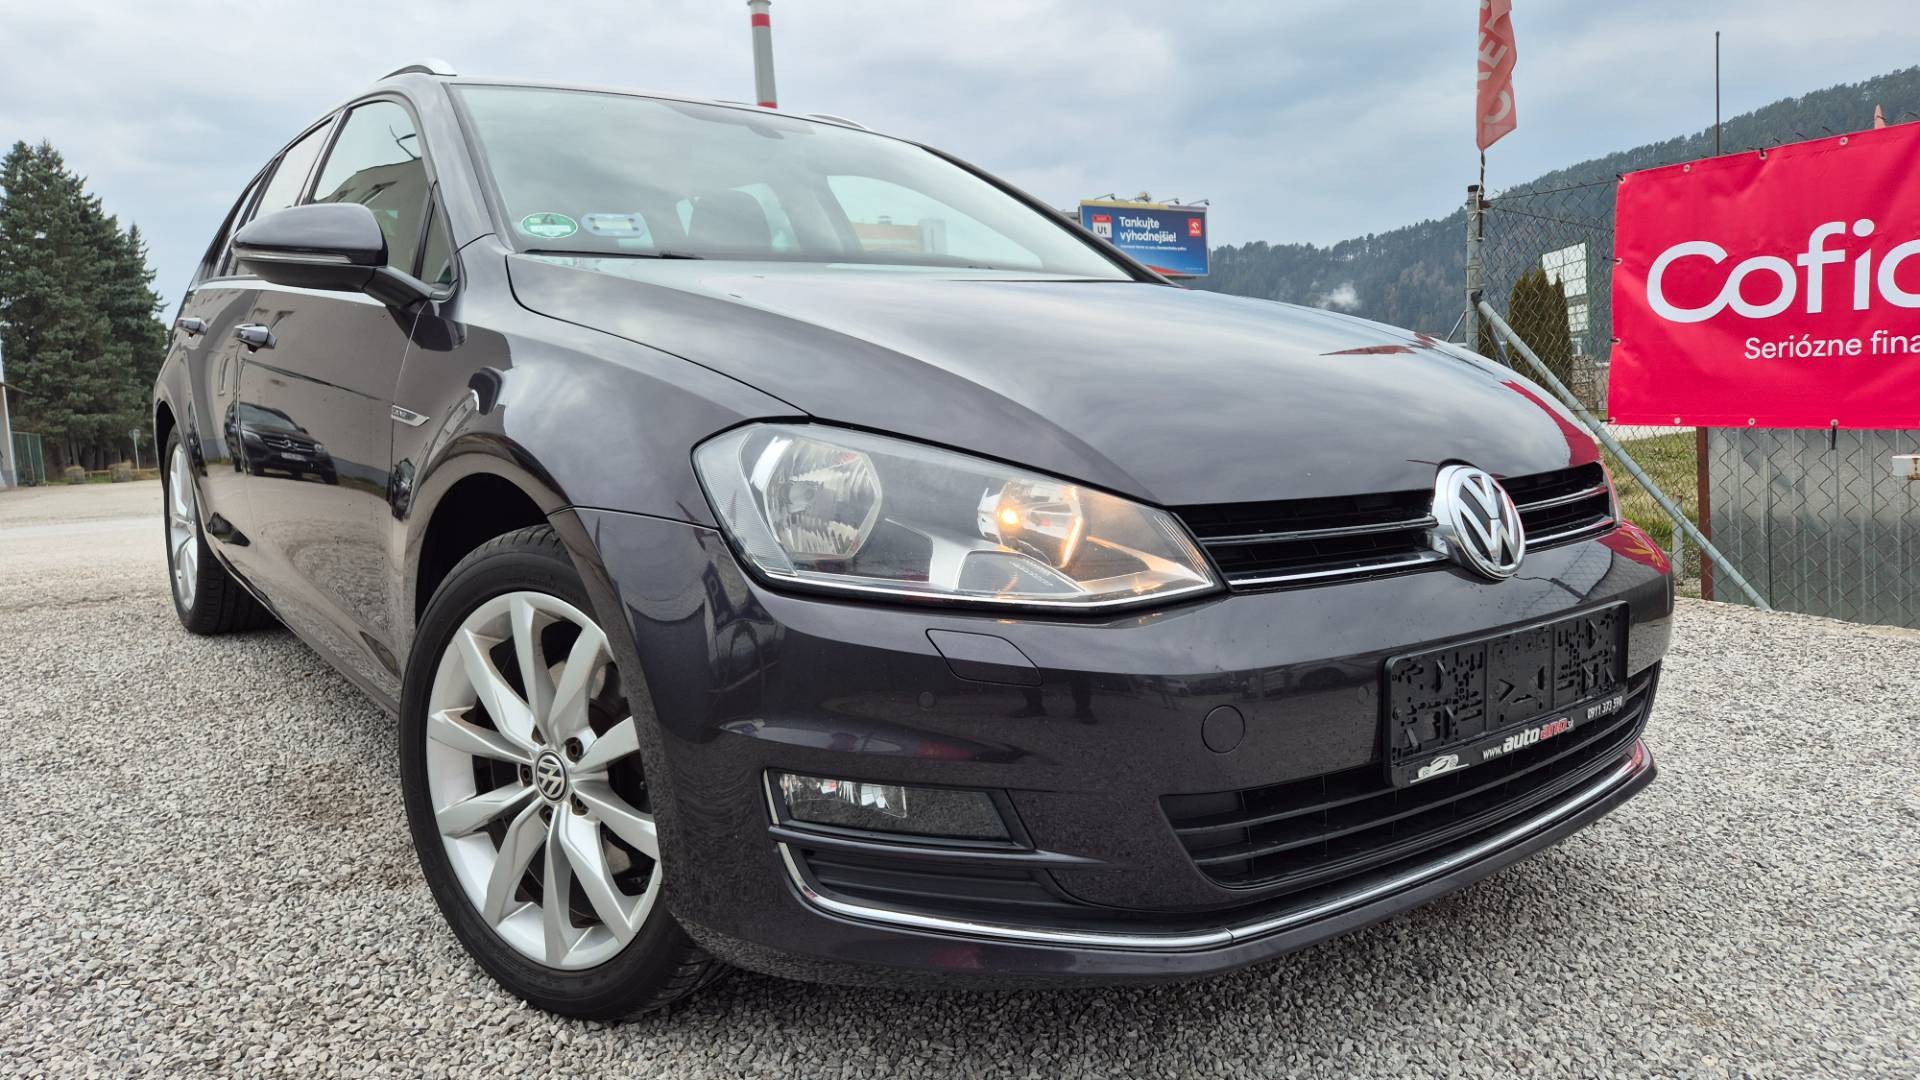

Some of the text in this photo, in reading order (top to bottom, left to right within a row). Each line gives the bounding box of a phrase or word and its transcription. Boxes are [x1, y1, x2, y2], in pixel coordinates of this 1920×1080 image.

[1119, 216, 1160, 230] Tankujte
[1120, 229, 1177, 243] výhodnejšie!
[1744, 334, 1862, 360] Seriózne
